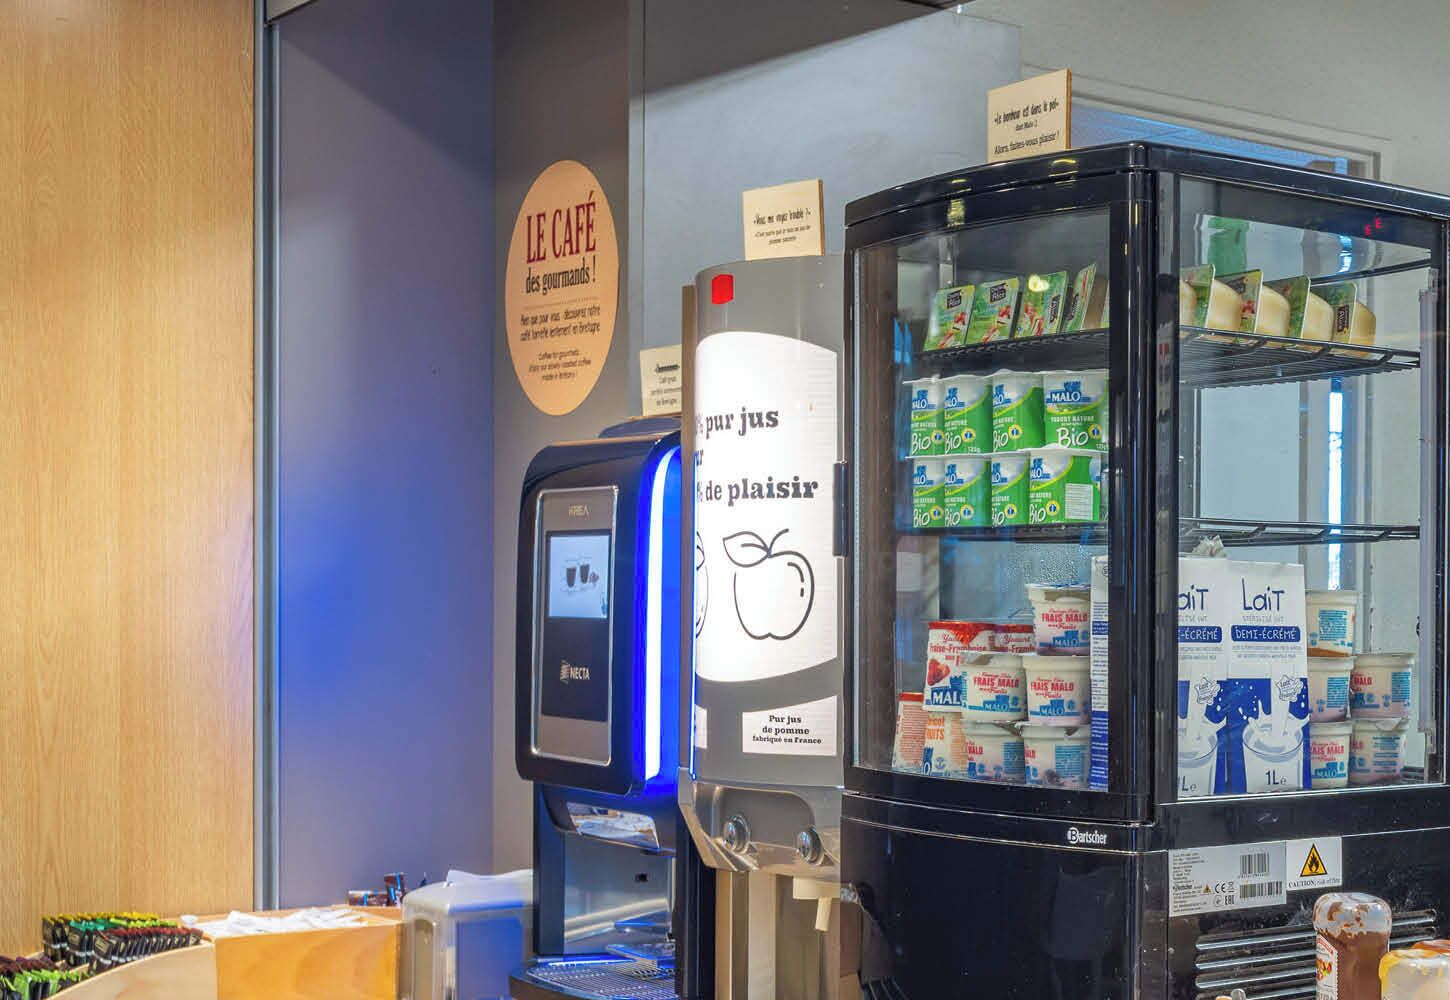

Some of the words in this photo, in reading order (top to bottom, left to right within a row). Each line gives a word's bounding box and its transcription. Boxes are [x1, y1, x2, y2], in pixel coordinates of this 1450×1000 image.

[527, 213, 547, 263] LE
[552, 190, 597, 259] CAFÉ
[526, 267, 540, 294] des
[542, 262, 591, 296] gourmands
[1051, 391, 1081, 402] MALO
[706, 411, 735, 439] pur
[738, 405, 780, 437] jus
[1056, 427, 1089, 449] Bio
[705, 476, 722, 501] de
[727, 475, 820, 507] plaisir
[1235, 627, 1297, 640] DEMI-ÉCRÉMÉ
[570, 666, 590, 680] NECTA
[932, 690, 961, 705] MAL
[769, 714, 785, 723] Pur
[787, 715, 802, 725] jus
[762, 726, 773, 734] de
[774, 727, 810, 737] pomme
[752, 735, 782, 744] fabriqué
[794, 736, 822, 745] France
[1067, 827, 1107, 844] Bartscher
